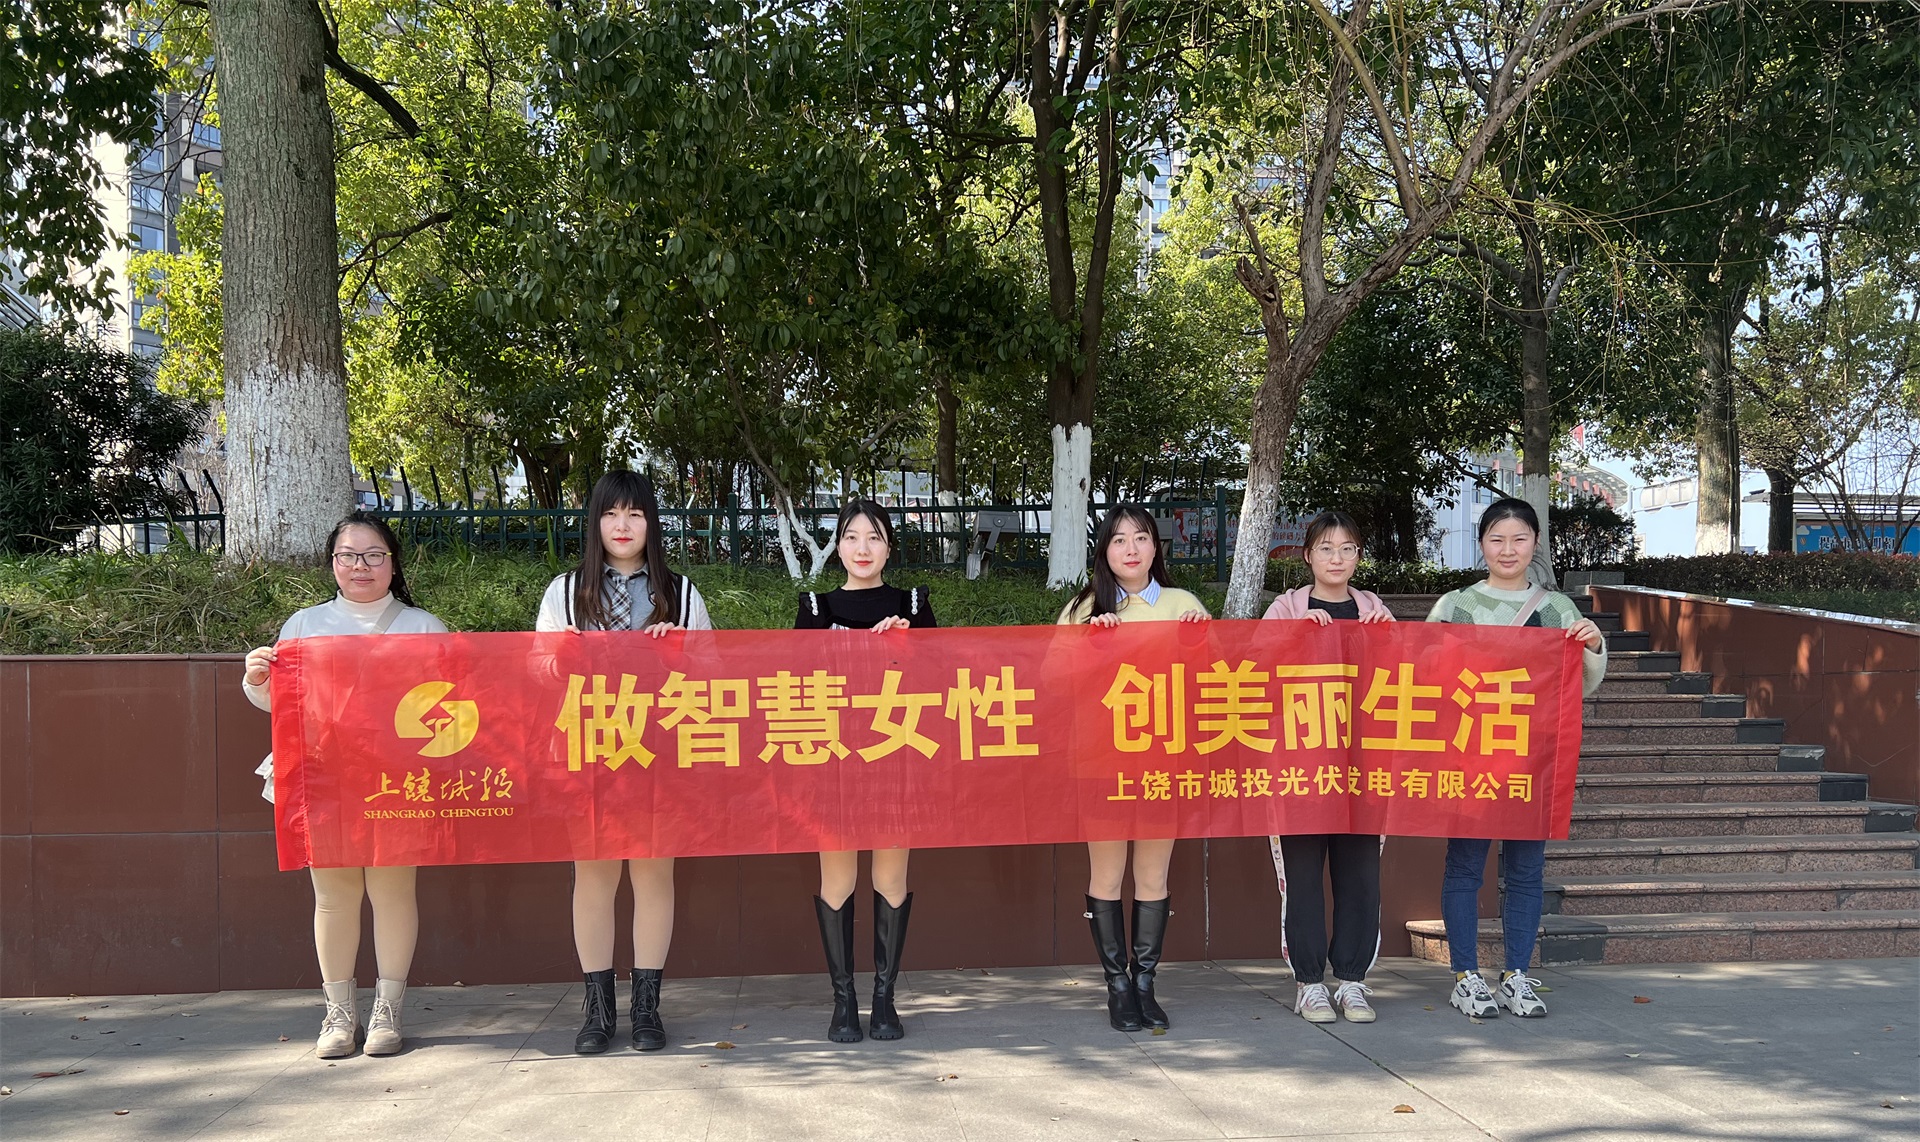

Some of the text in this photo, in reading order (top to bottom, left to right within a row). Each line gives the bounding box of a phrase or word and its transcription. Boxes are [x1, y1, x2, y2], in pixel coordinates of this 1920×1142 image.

[555, 659, 1536, 771] 做智慧女性 创美丽生活
[1107, 765, 1533, 803] 上饶市城投光伏发电有限公司
[364, 807, 514, 820] SHANGRAO CHENGTOU
